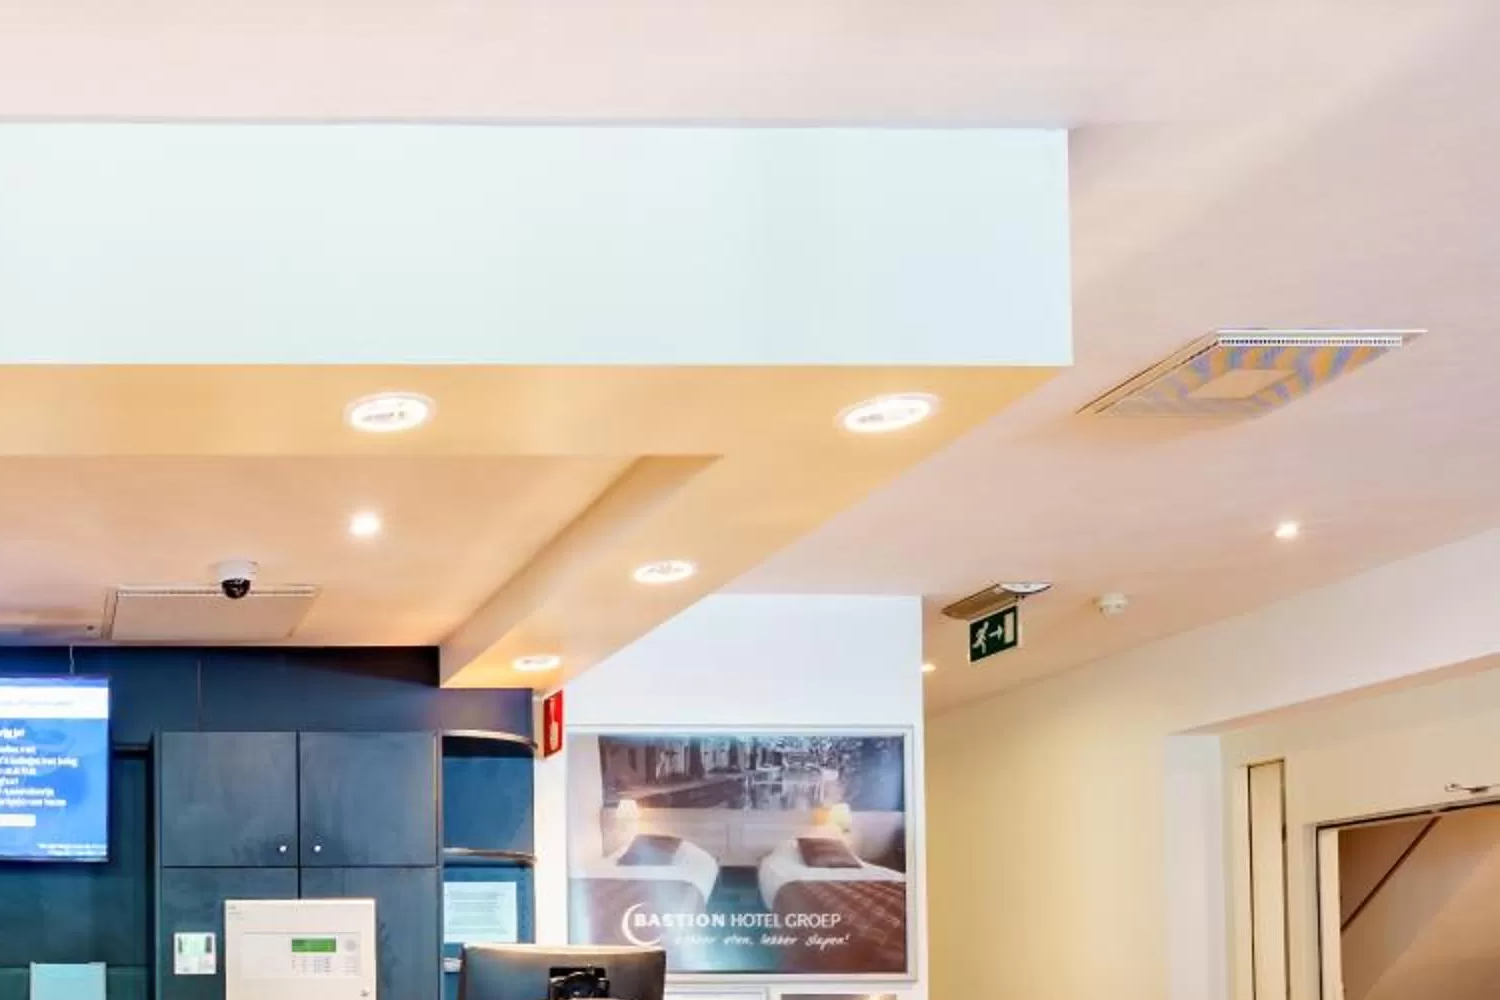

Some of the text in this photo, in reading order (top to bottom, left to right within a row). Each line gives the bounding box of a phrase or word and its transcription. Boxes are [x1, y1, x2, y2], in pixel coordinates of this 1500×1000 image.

[633, 913, 842, 928] BASTION HOTEL GROEP
